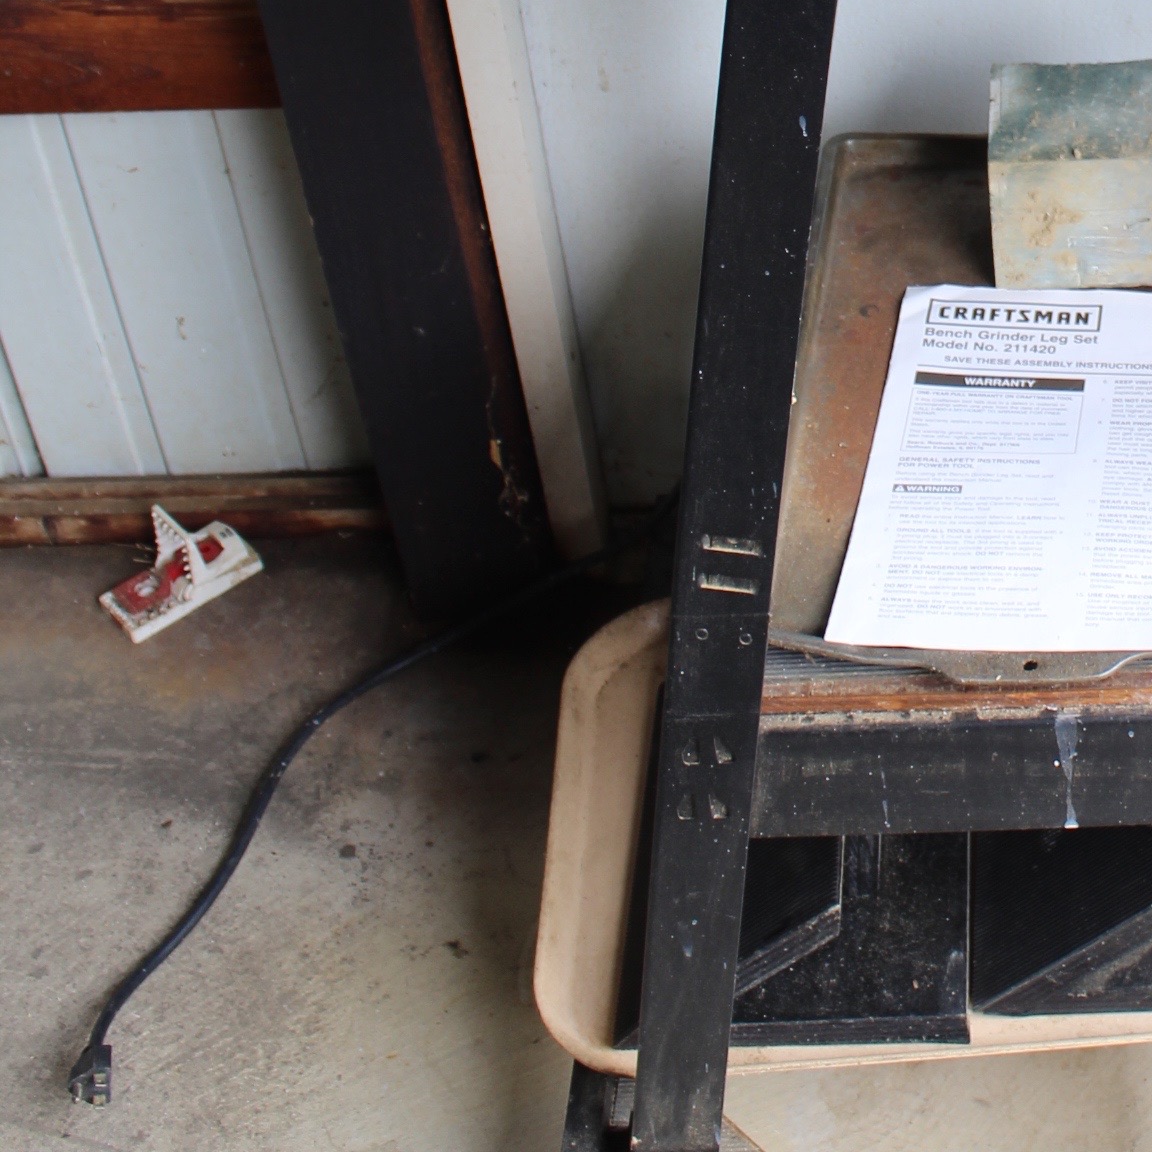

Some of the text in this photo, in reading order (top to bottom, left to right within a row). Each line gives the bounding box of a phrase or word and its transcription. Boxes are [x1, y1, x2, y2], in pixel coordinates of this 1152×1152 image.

[937, 305, 1091, 326] CRAFTSMAN
[924, 327, 1099, 345] Bench Grinder Leg Set
[922, 338, 1057, 354] Model No. 211420
[944, 355, 972, 364] SAVE
[976, 357, 1011, 366] THESE
[1013, 359, 1073, 368] ASSEMBLY
[964, 376, 1037, 388] WARRANTY
[906, 485, 960, 493] WARNING
